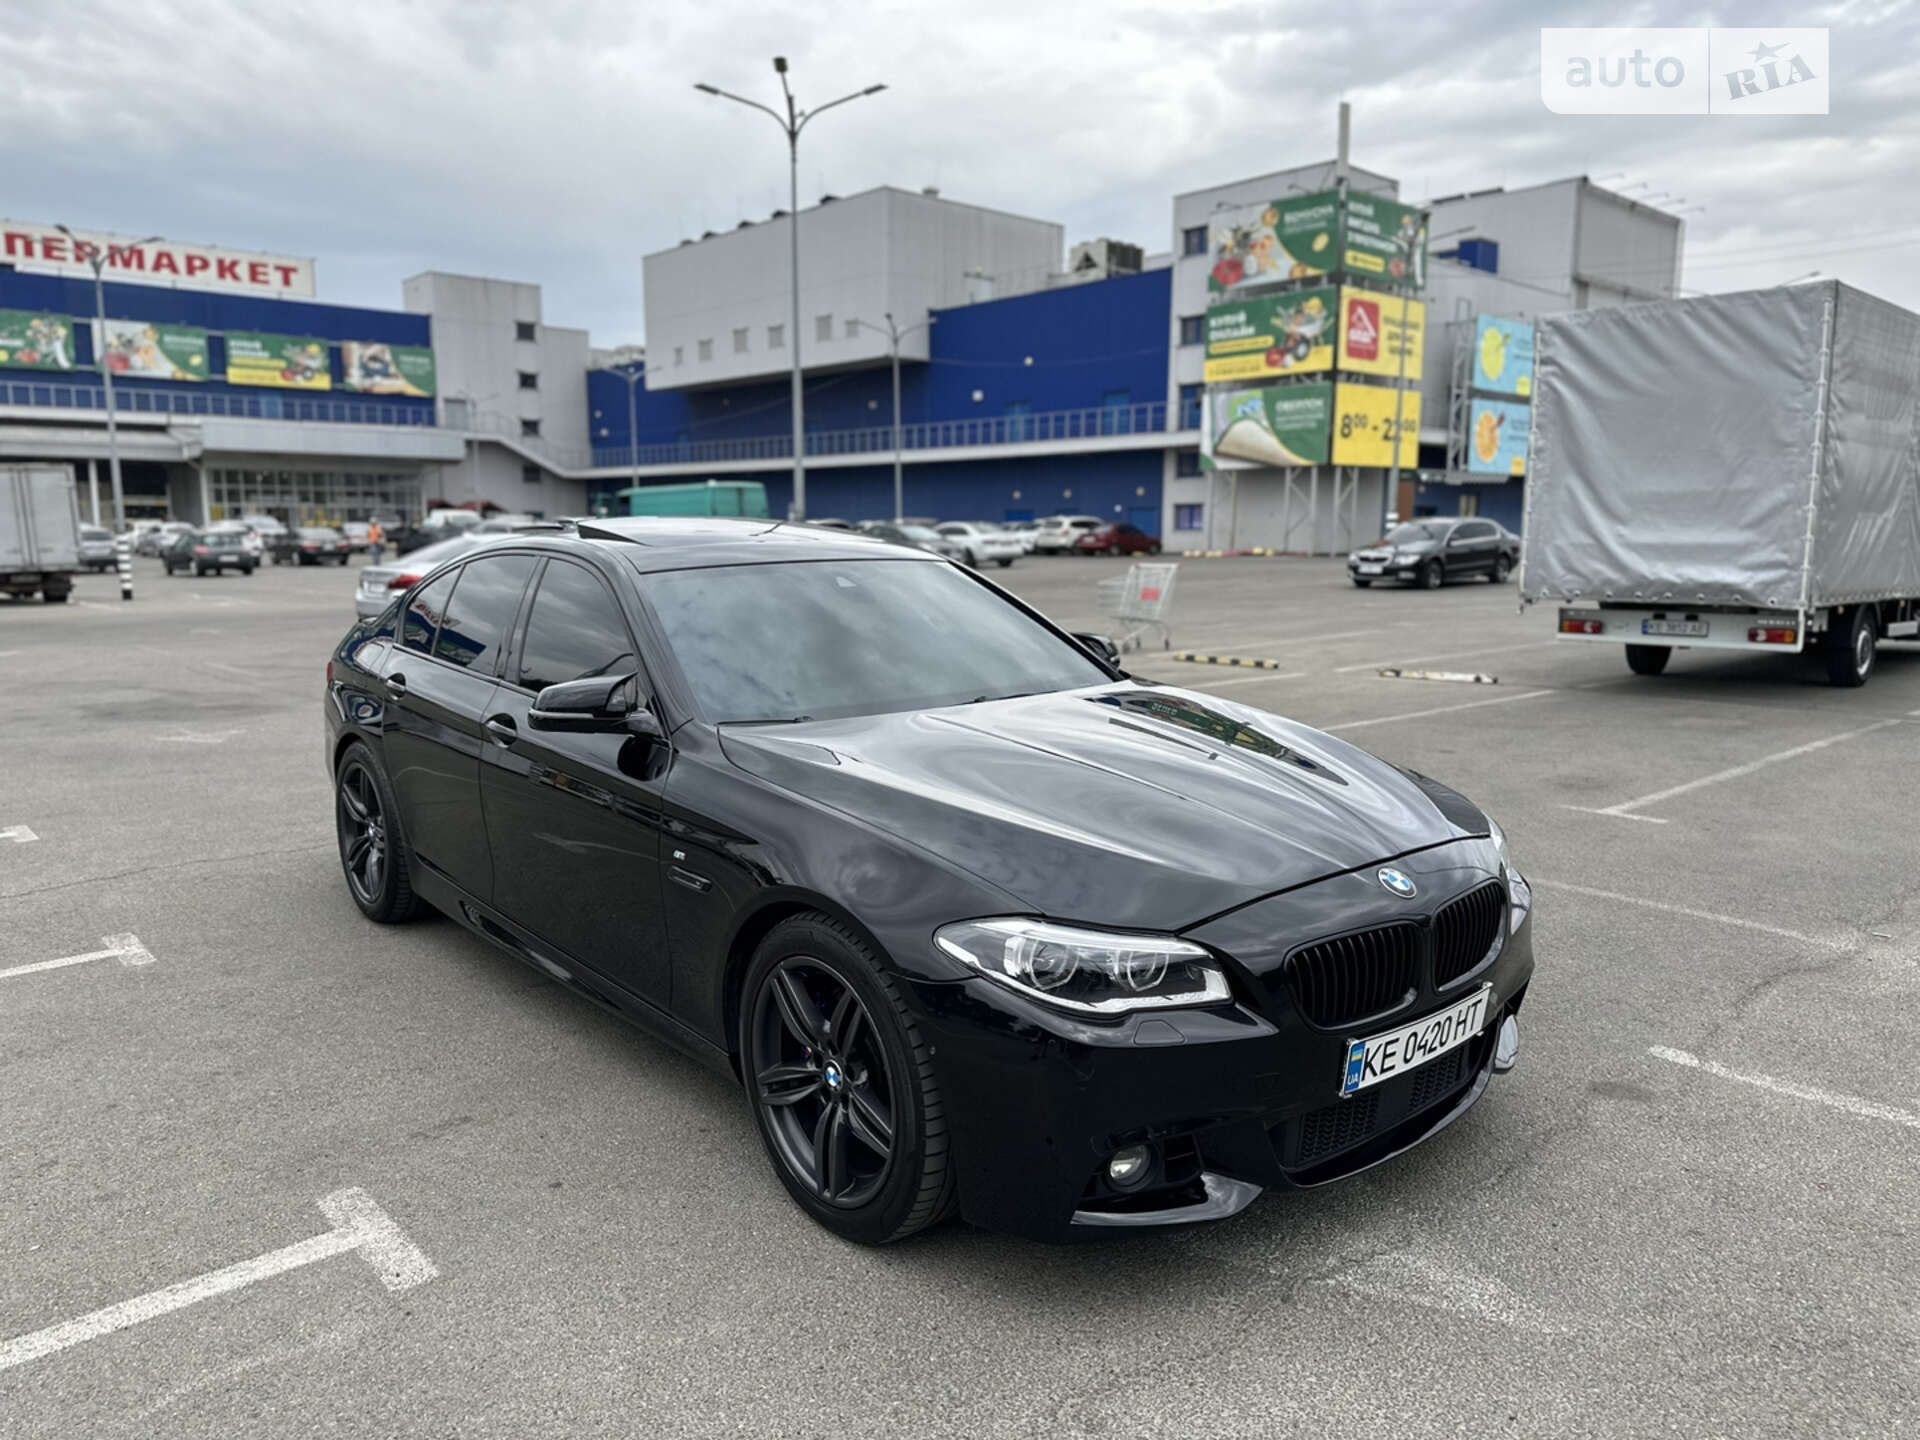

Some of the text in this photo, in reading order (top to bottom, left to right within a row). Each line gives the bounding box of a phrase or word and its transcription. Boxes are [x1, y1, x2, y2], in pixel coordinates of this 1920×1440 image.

[4, 231, 299, 288] ПЕРМАРКЕТ
[1361, 998, 1484, 1082] KE 0420 HT
[1346, 1073, 1360, 1086] UA
